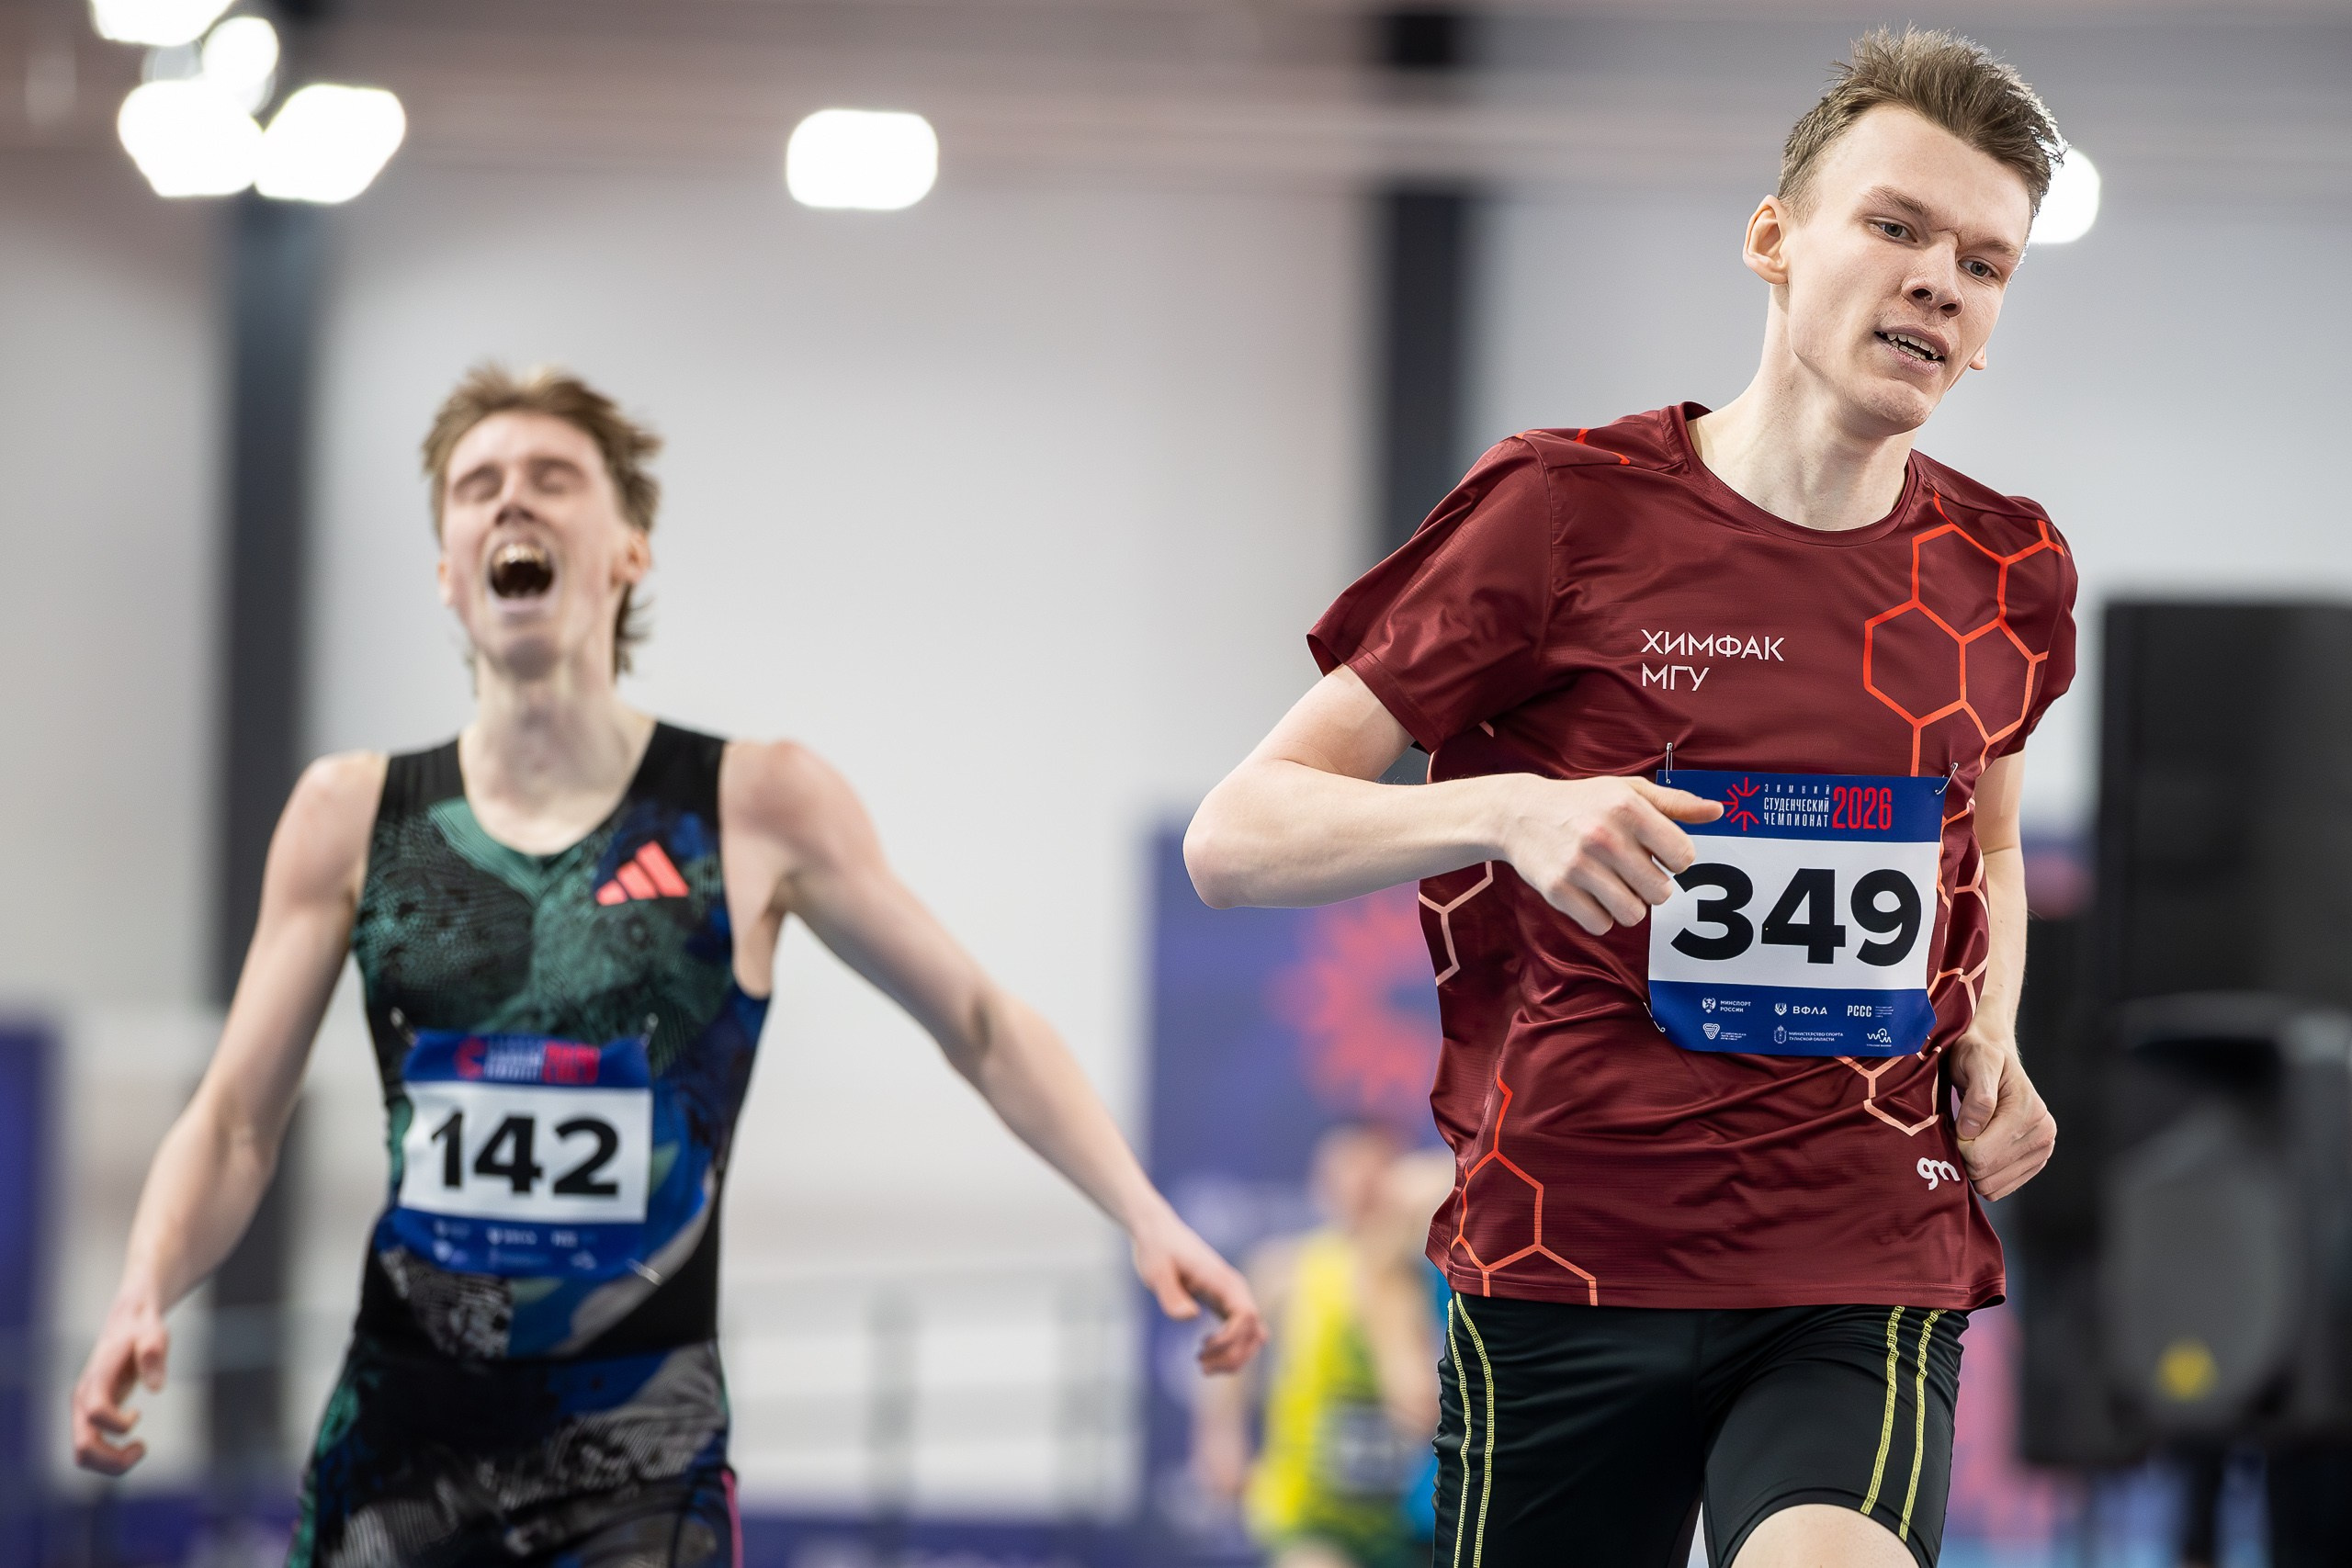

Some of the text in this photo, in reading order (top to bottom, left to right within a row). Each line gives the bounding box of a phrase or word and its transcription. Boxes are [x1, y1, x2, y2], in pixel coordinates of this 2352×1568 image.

[1640, 628, 1785, 662] ХИМФАК
[1642, 662, 1710, 692] МГУ
[1764, 784, 1830, 795] ЗИМНИЙ
[1763, 796, 1829, 813] СТУДЕНЧЕСКИЙ
[1832, 785, 1893, 830] 2026
[1763, 812, 1828, 828] ЧЕМПИОНАТ
[1670, 863, 1922, 966] 349
[1792, 1005, 1827, 1015] ВФЛА
[1847, 1004, 1872, 1018] РССС
[431, 1108, 619, 1197] 142
